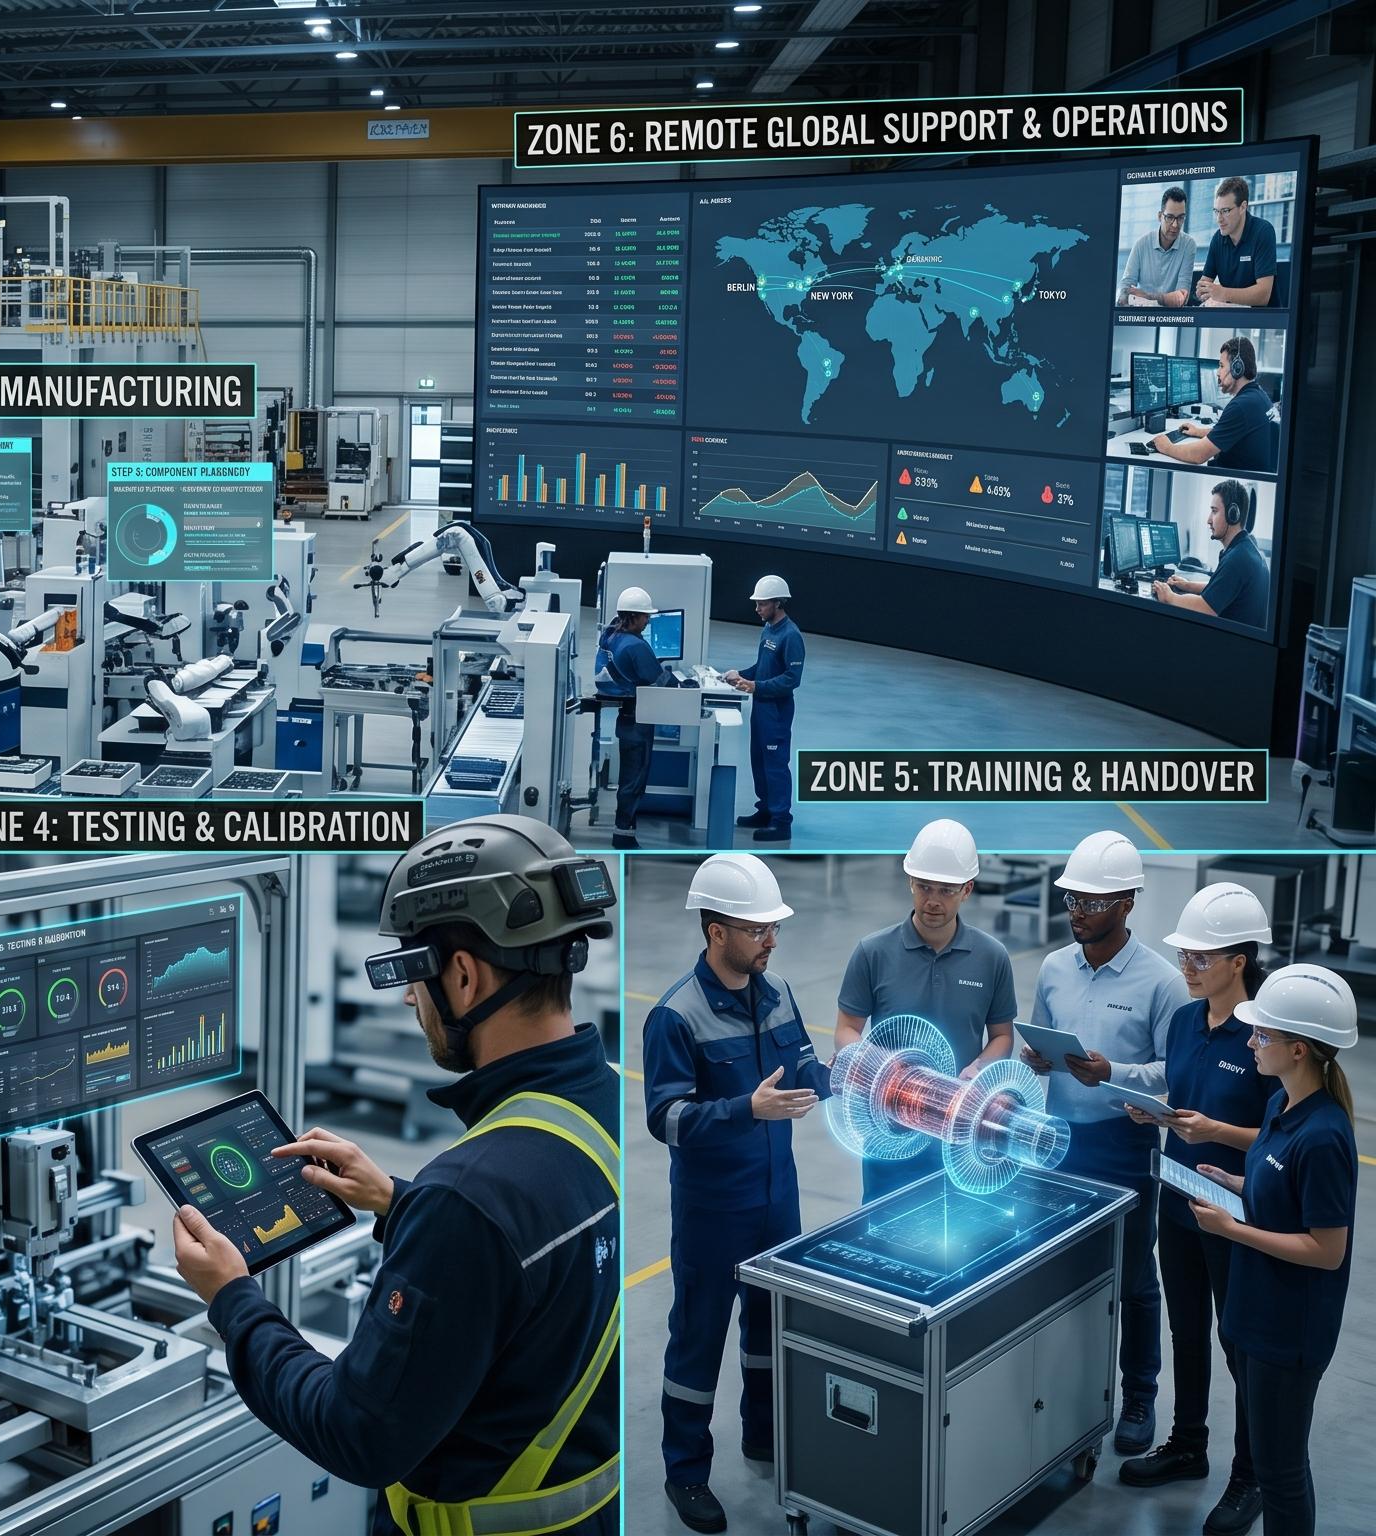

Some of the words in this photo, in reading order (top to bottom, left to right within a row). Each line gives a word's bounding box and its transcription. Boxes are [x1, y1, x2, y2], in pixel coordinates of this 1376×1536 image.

[727, 283, 755, 292] BERLIN
[810, 291, 830, 300] NEW
[831, 291, 854, 300] YORK
[1039, 290, 1067, 300] TOKYO
